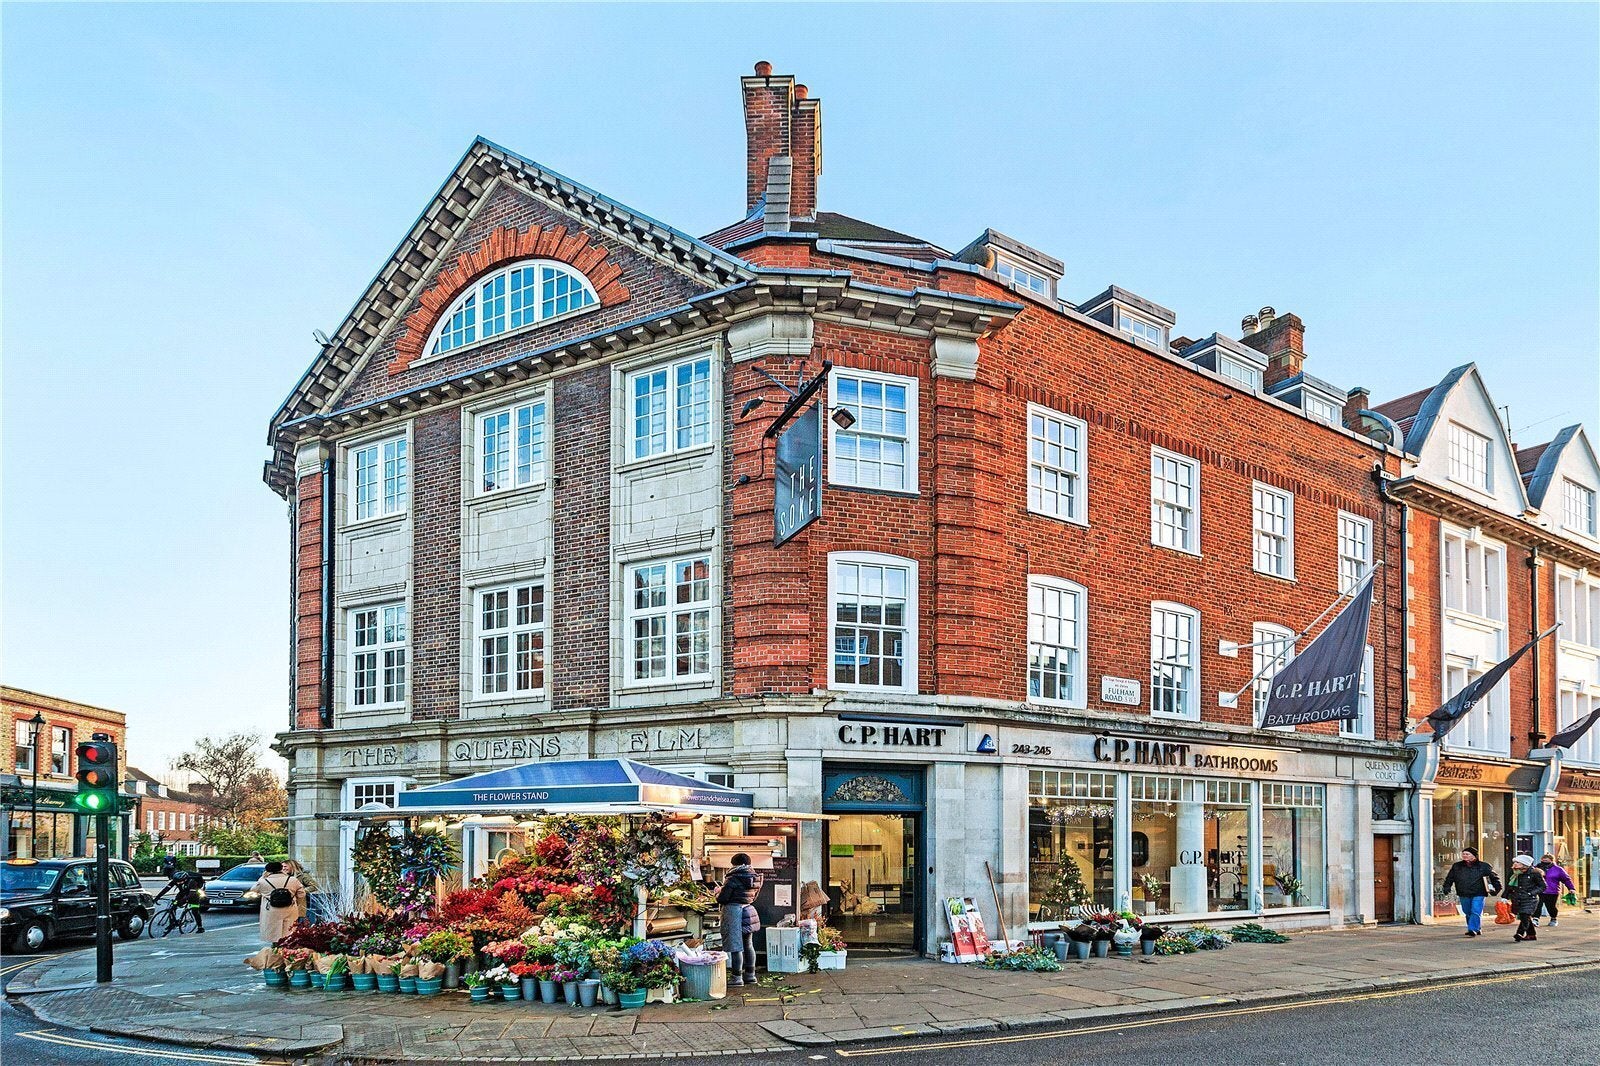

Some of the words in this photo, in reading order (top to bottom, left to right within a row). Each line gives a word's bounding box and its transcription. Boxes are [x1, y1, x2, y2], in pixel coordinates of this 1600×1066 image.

[790, 454, 815, 499] THE
[780, 486, 815, 536] SOKE
[1108, 687, 1135, 697] FULHAM
[1306, 672, 1356, 698] HART
[1267, 705, 1351, 725] BATHROOMS
[883, 727, 946, 747] HART
[344, 745, 398, 767] THE
[453, 736, 560, 761] QUEENS
[630, 728, 702, 752] ELM
[1012, 743, 1052, 756] 243-245
[1134, 741, 1190, 767] HART
[1194, 753, 1278, 773] BATHROOMS
[1364, 760, 1390, 770] QUEENS
[1392, 762, 1406, 772] ELM
[1375, 771, 1396, 780] COURT
[473, 792, 487, 801] THE
[489, 792, 521, 801] FLOWER
[522, 791, 549, 800] STAND
